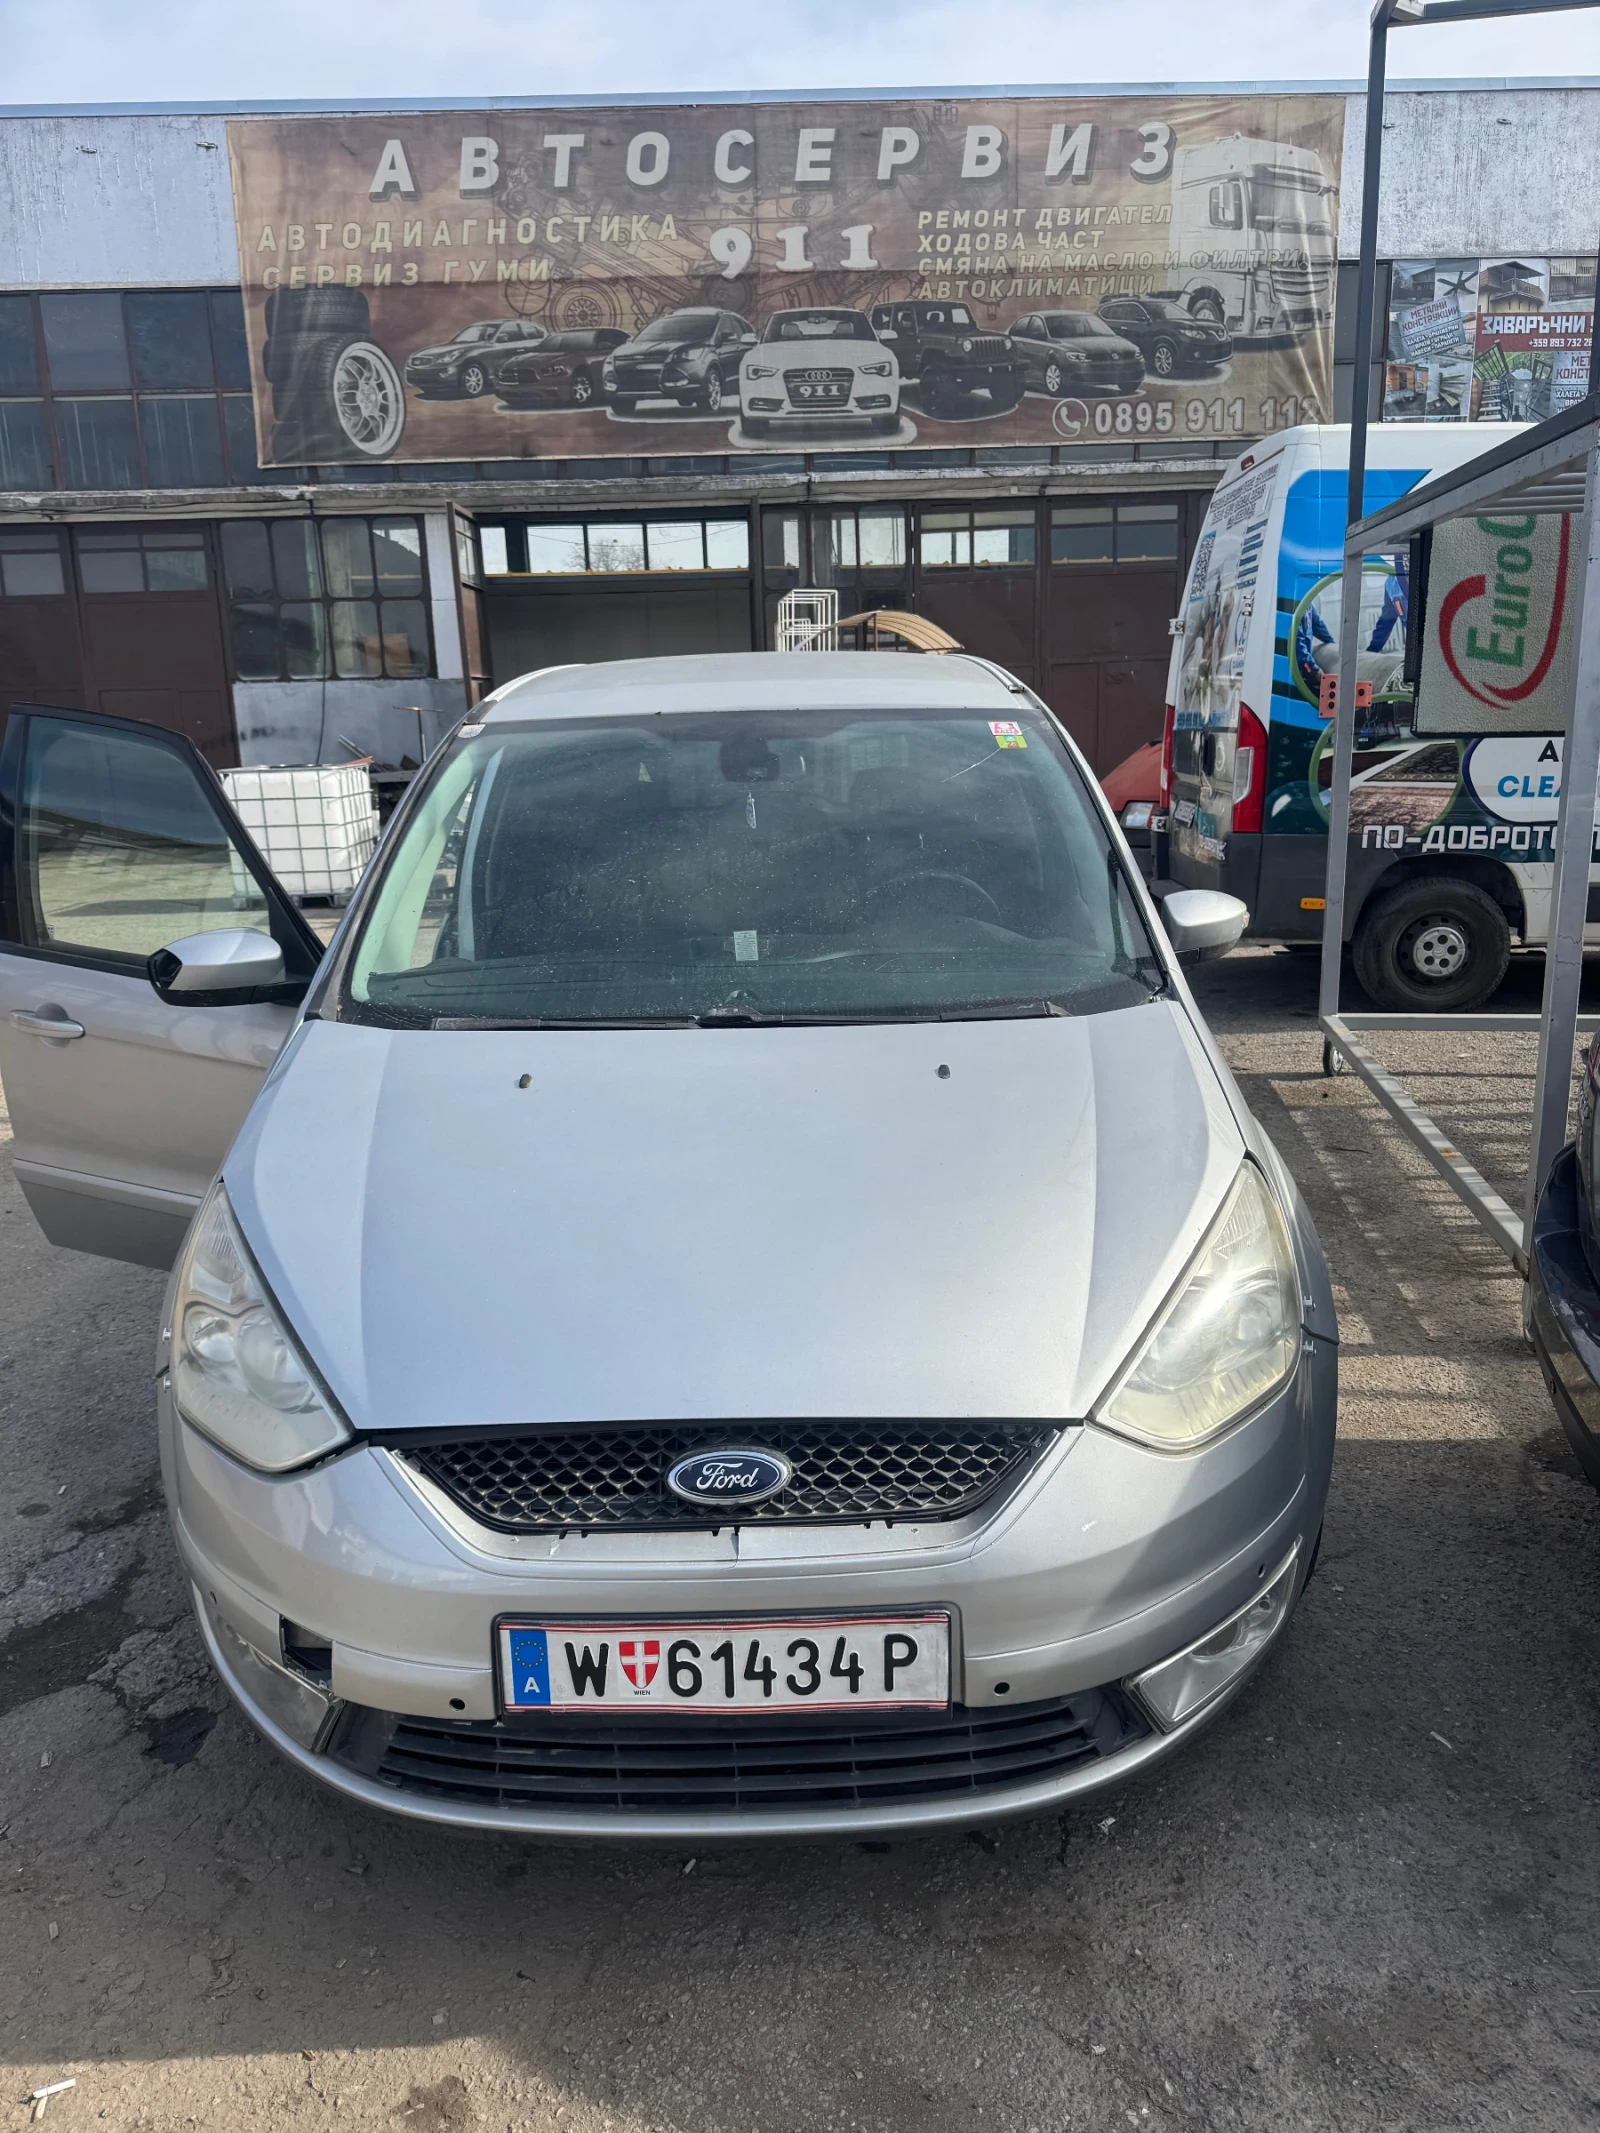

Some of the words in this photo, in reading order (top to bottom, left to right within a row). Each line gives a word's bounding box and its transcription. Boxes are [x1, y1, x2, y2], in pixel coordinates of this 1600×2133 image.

[370, 121, 1172, 194] АВТОСЕРВИЗ
[917, 208, 1026, 230] РЕМОНТ
[1035, 204, 1173, 227] ДВИГАТЕЛ
[256, 213, 679, 253] АВТОДИАГНОСТИКА
[917, 231, 1025, 254] ХОДОВА
[1037, 229, 1105, 250] ЧАСТ
[709, 225, 880, 279] 911
[916, 256, 1009, 277] СМЯНА
[1018, 255, 1053, 275] НА
[1064, 252, 1156, 273] МАСЛО
[262, 261, 420, 290] СЕРВИЗ
[443, 257, 552, 285] ГУМИ
[915, 274, 1156, 301] АВТОКЛИМАТИЦИ
[1482, 315, 1586, 335] ЗАВАРЪЧНИ
[1549, 338, 1565, 348] 893
[1567, 338, 1582, 347] 732
[799, 385, 841, 398] 911
[1095, 400, 1174, 434] 0895
[1185, 398, 1246, 432] 911
[697, 1462, 758, 1490] Ford
[564, 1641, 609, 1698] W
[667, 1635, 864, 1699] 61434
[883, 1633, 918, 1692] P
[523, 1676, 540, 1693] A
